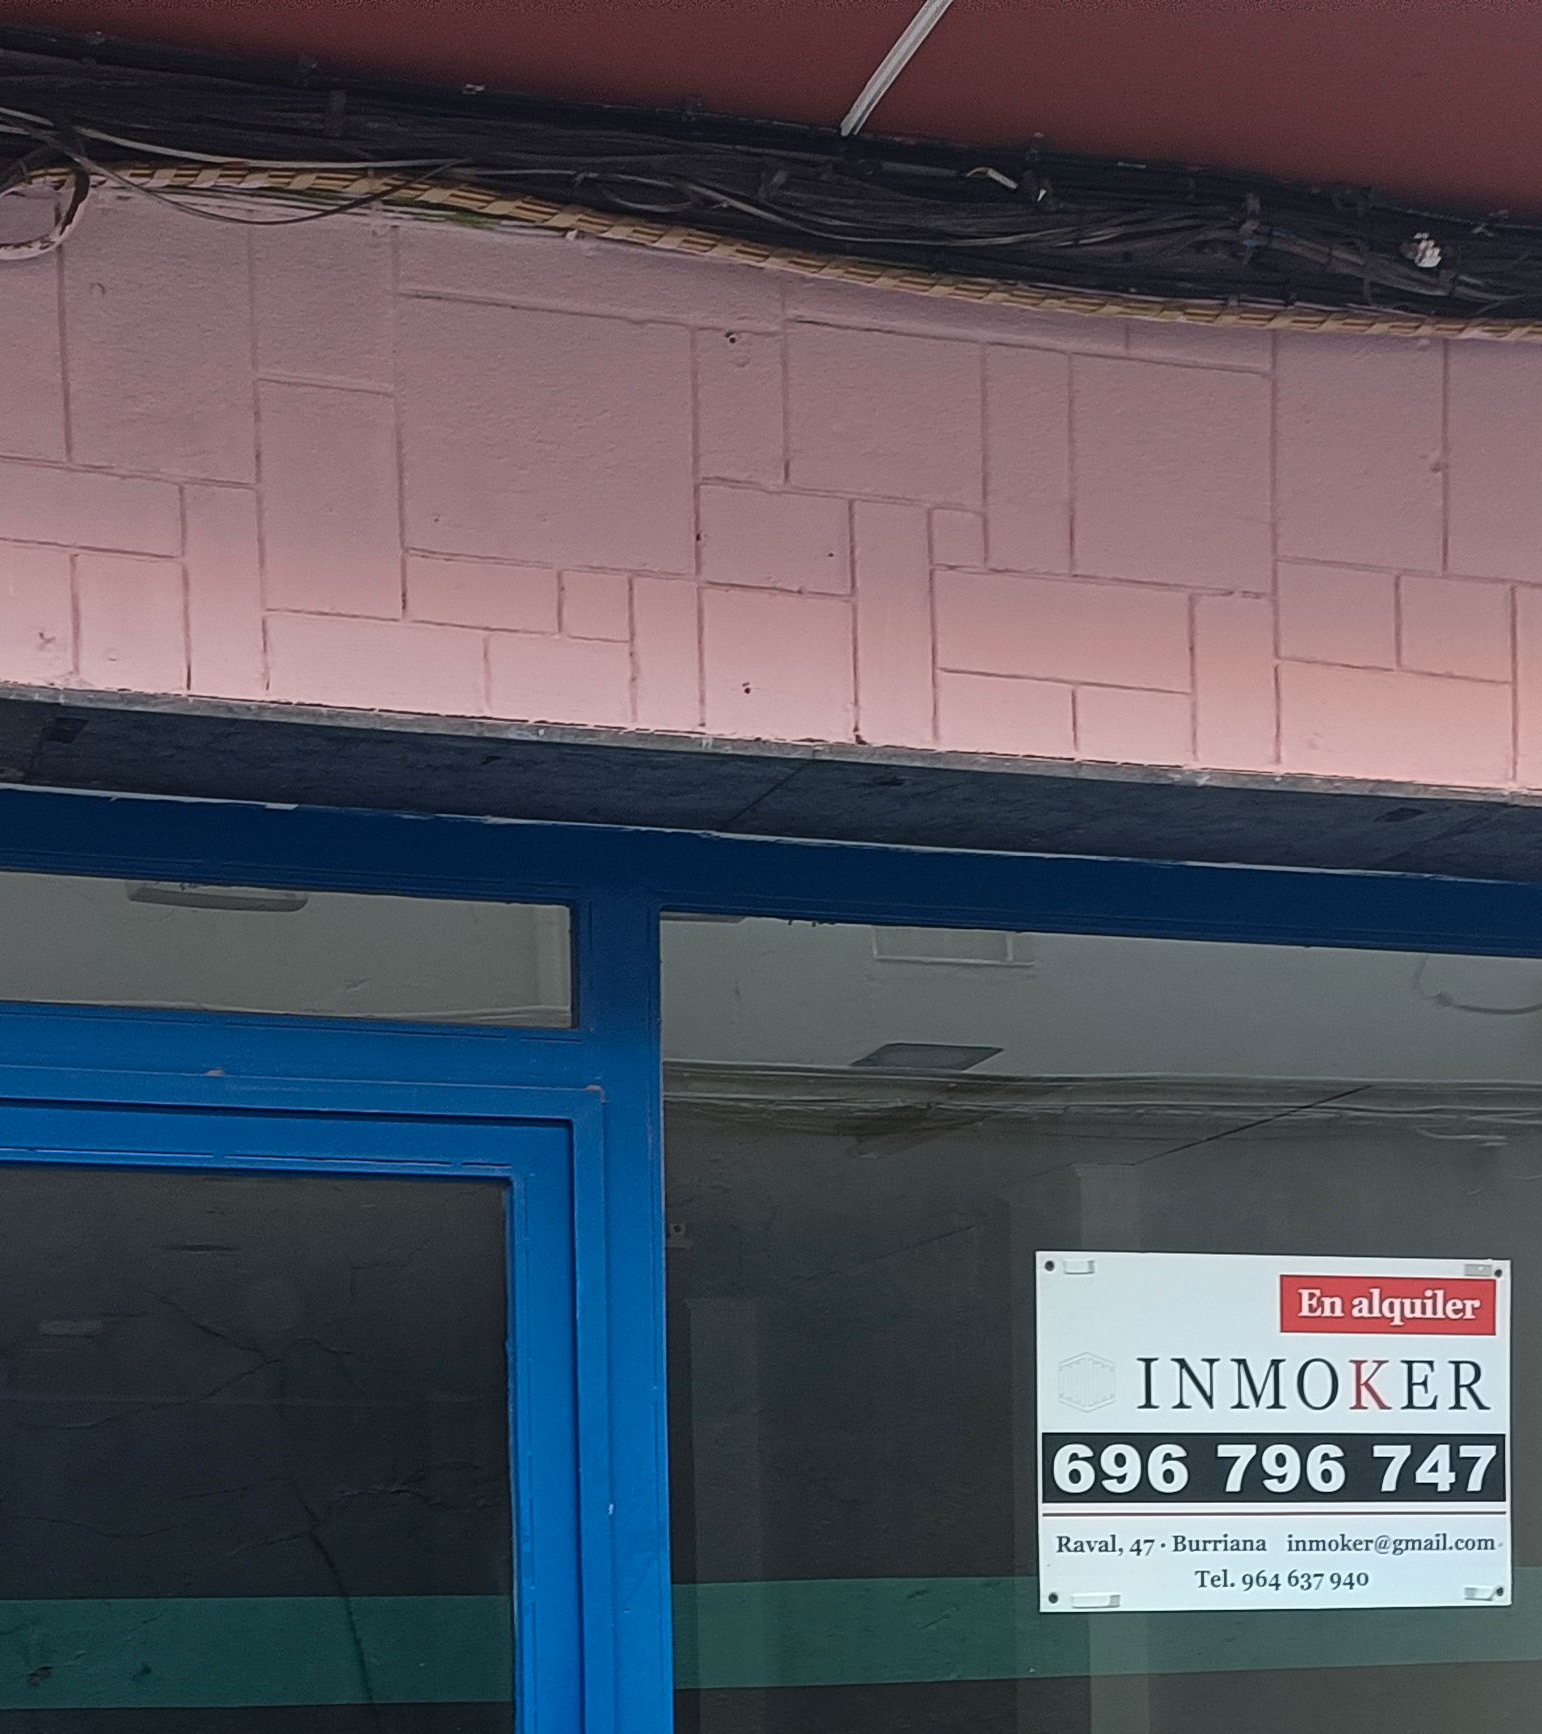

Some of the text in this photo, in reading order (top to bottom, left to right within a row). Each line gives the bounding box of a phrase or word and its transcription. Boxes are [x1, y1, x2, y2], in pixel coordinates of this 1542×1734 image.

[1297, 1287, 1481, 1327] En alquiler
[1136, 1356, 1491, 1411] INMOKER
[1052, 1442, 1498, 1494] 696 796 747
[1056, 1534, 1124, 1557] Raval,
[1129, 1538, 1156, 1557] 47
[1172, 1533, 1268, 1553] Burriana
[1287, 1533, 1496, 1556] inmoker@gmail.com
[1194, 1569, 1370, 1592] Tel. 964 637 940
